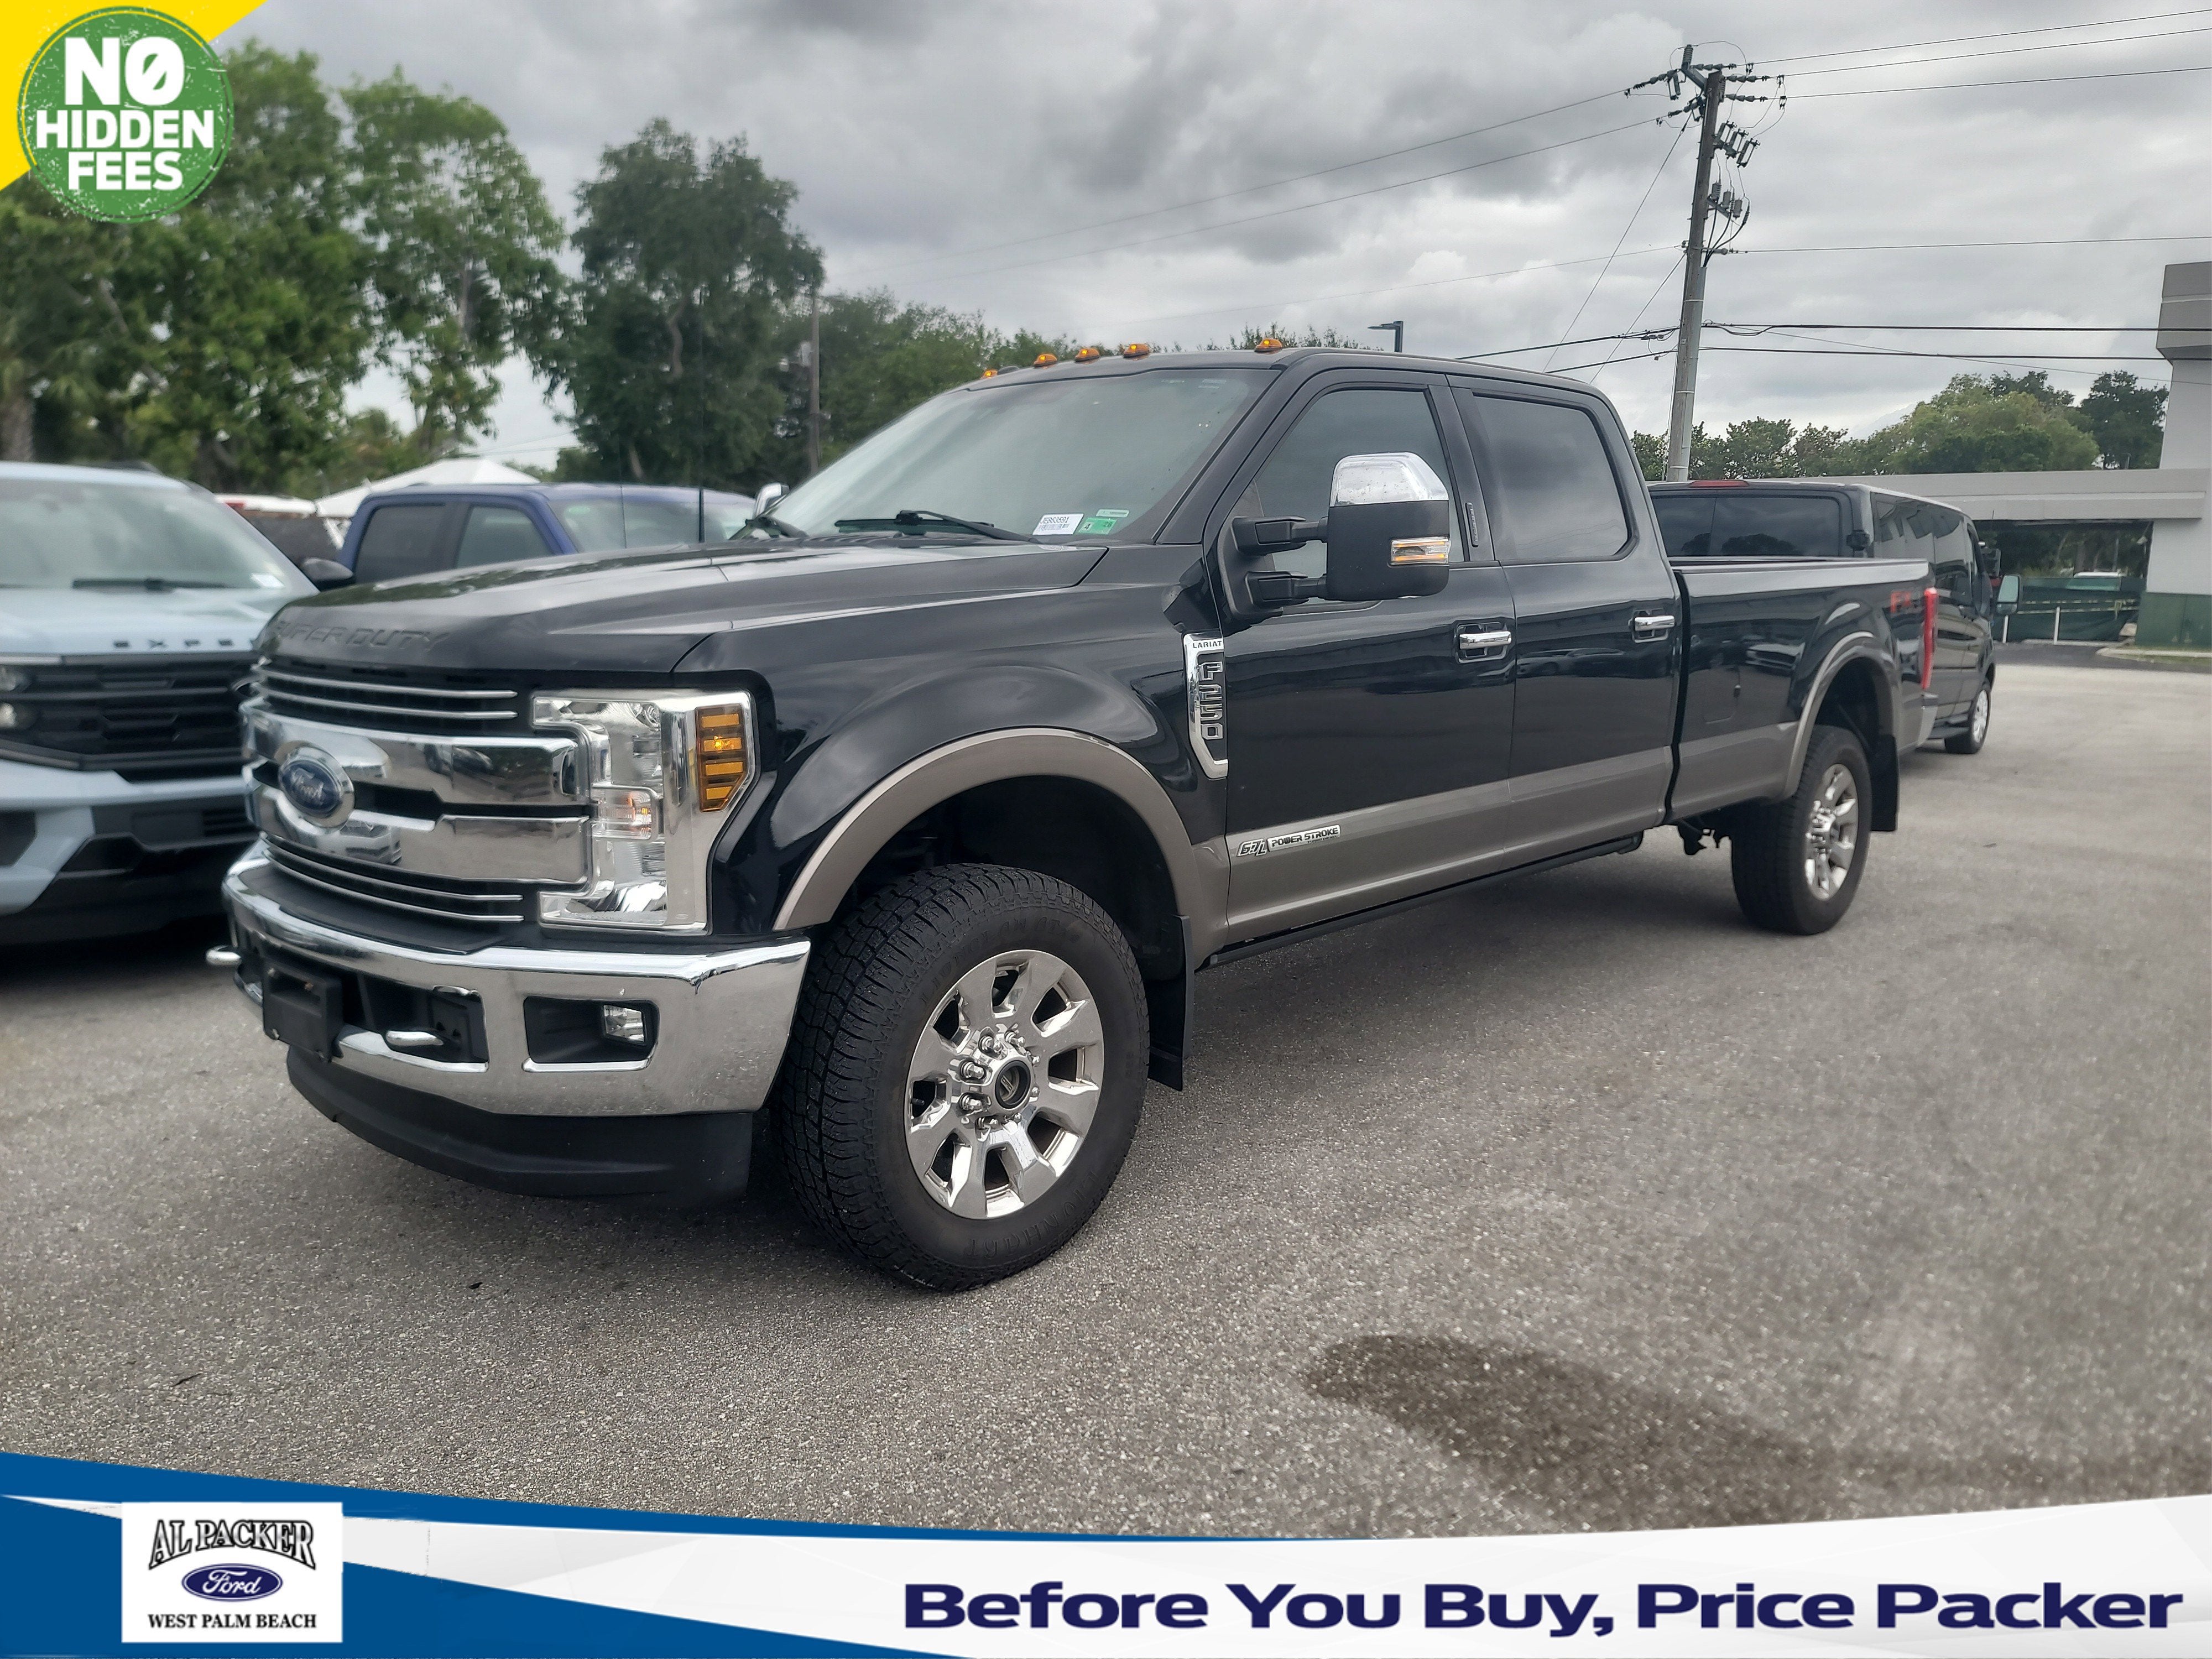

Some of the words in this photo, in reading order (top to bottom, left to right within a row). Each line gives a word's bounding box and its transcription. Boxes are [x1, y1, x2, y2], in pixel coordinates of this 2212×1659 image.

[1192, 640, 1222, 649] LARIAT
[1238, 839, 1267, 857] 6.7L
[1271, 834, 1303, 847] POWER
[1304, 827, 1338, 840] STROKE
